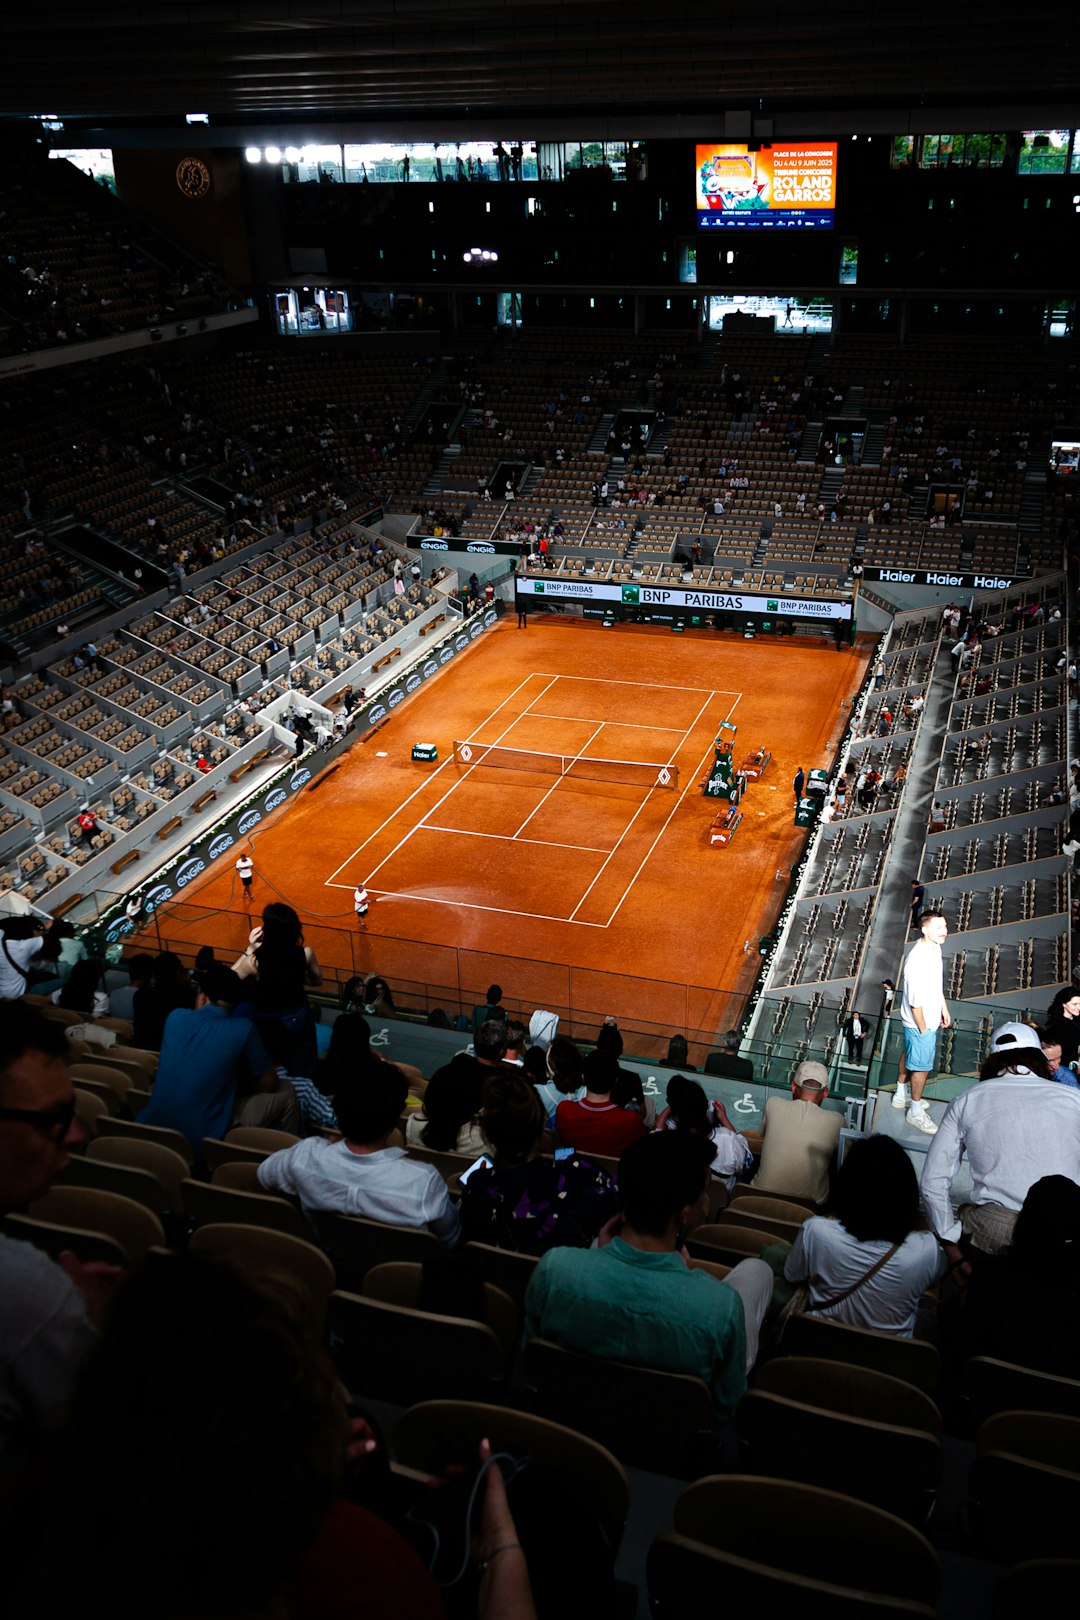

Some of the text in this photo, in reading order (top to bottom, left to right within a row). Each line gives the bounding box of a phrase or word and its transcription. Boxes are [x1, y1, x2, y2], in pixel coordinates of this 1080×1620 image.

[773, 176, 832, 189] ROLAND
[773, 188, 832, 202] GARROS
[880, 570, 916, 582] Haier
[926, 573, 963, 586] Haier
[974, 576, 1012, 588] Haier
[563, 584, 593, 593] PARIBAS
[643, 590, 743, 609] BNP PARIBAS
[799, 603, 832, 612] PARIBAS
